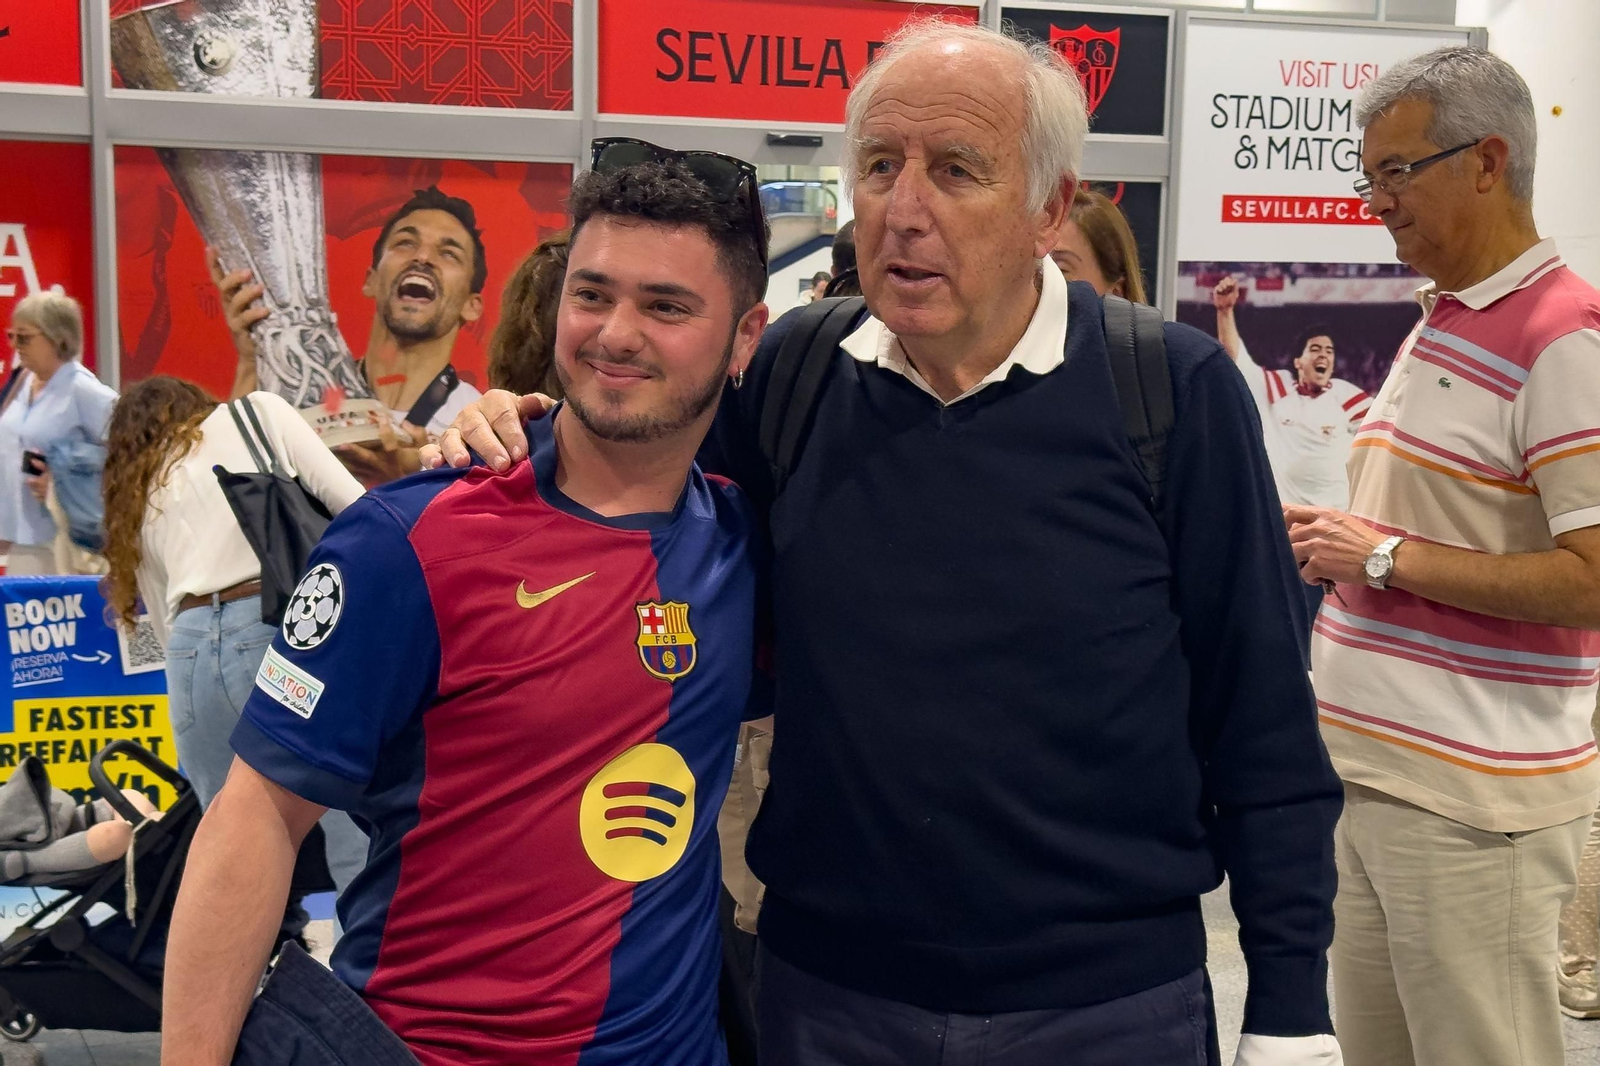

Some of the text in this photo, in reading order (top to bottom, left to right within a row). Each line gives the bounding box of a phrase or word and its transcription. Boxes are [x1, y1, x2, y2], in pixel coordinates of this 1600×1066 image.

[656, 27, 851, 89] SEVILLA
[1279, 60, 1337, 88] VISIT
[1211, 93, 1352, 132] STADIUM
[1234, 134, 1258, 169] &
[1231, 199, 1382, 221] SEVILLAFC.C
[5, 593, 86, 628] BOOK
[300, 589, 323, 620] 5
[8, 621, 77, 655] NOW
[12, 665, 63, 683] AHORA!
[29, 704, 155, 733] FASTEST
